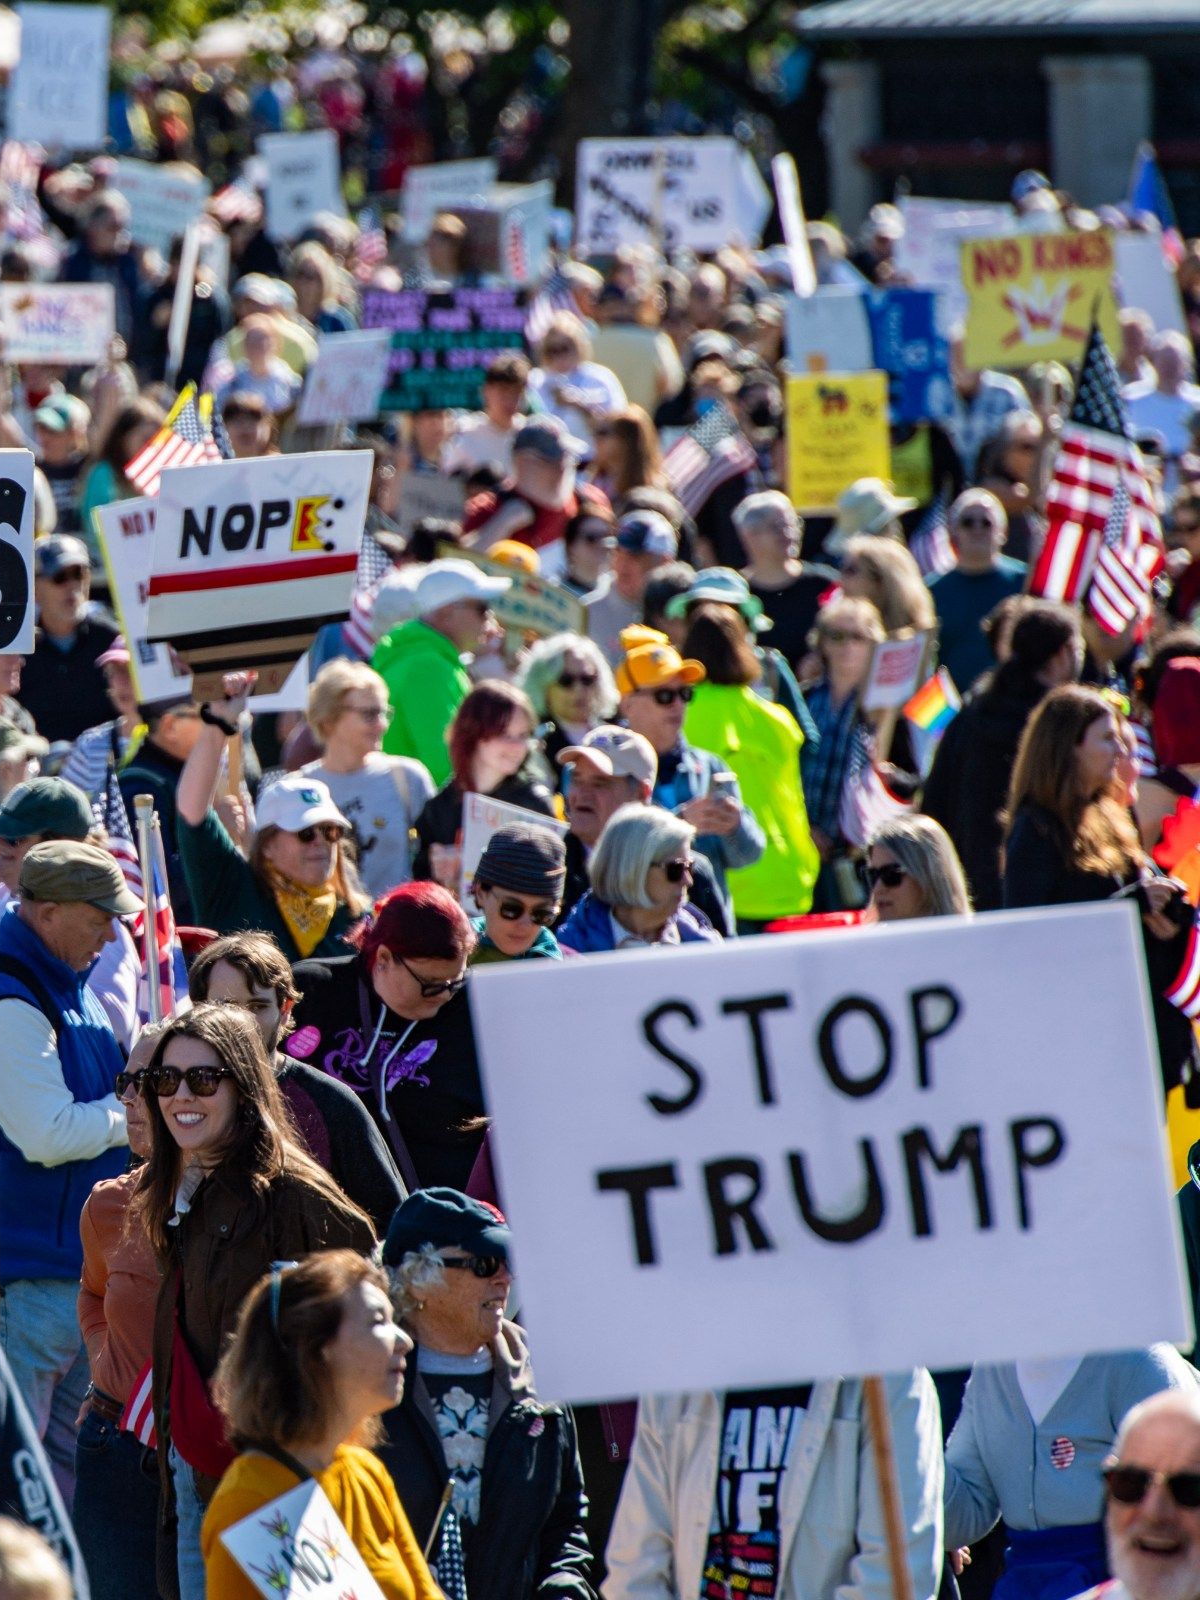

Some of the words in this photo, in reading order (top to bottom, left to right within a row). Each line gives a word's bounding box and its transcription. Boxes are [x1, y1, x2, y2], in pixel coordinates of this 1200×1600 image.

[973, 238, 1022, 285] NO
[641, 983, 963, 1115] STOP
[596, 1116, 1066, 1266] TRUMP
[281, 1540, 334, 1592] NO
